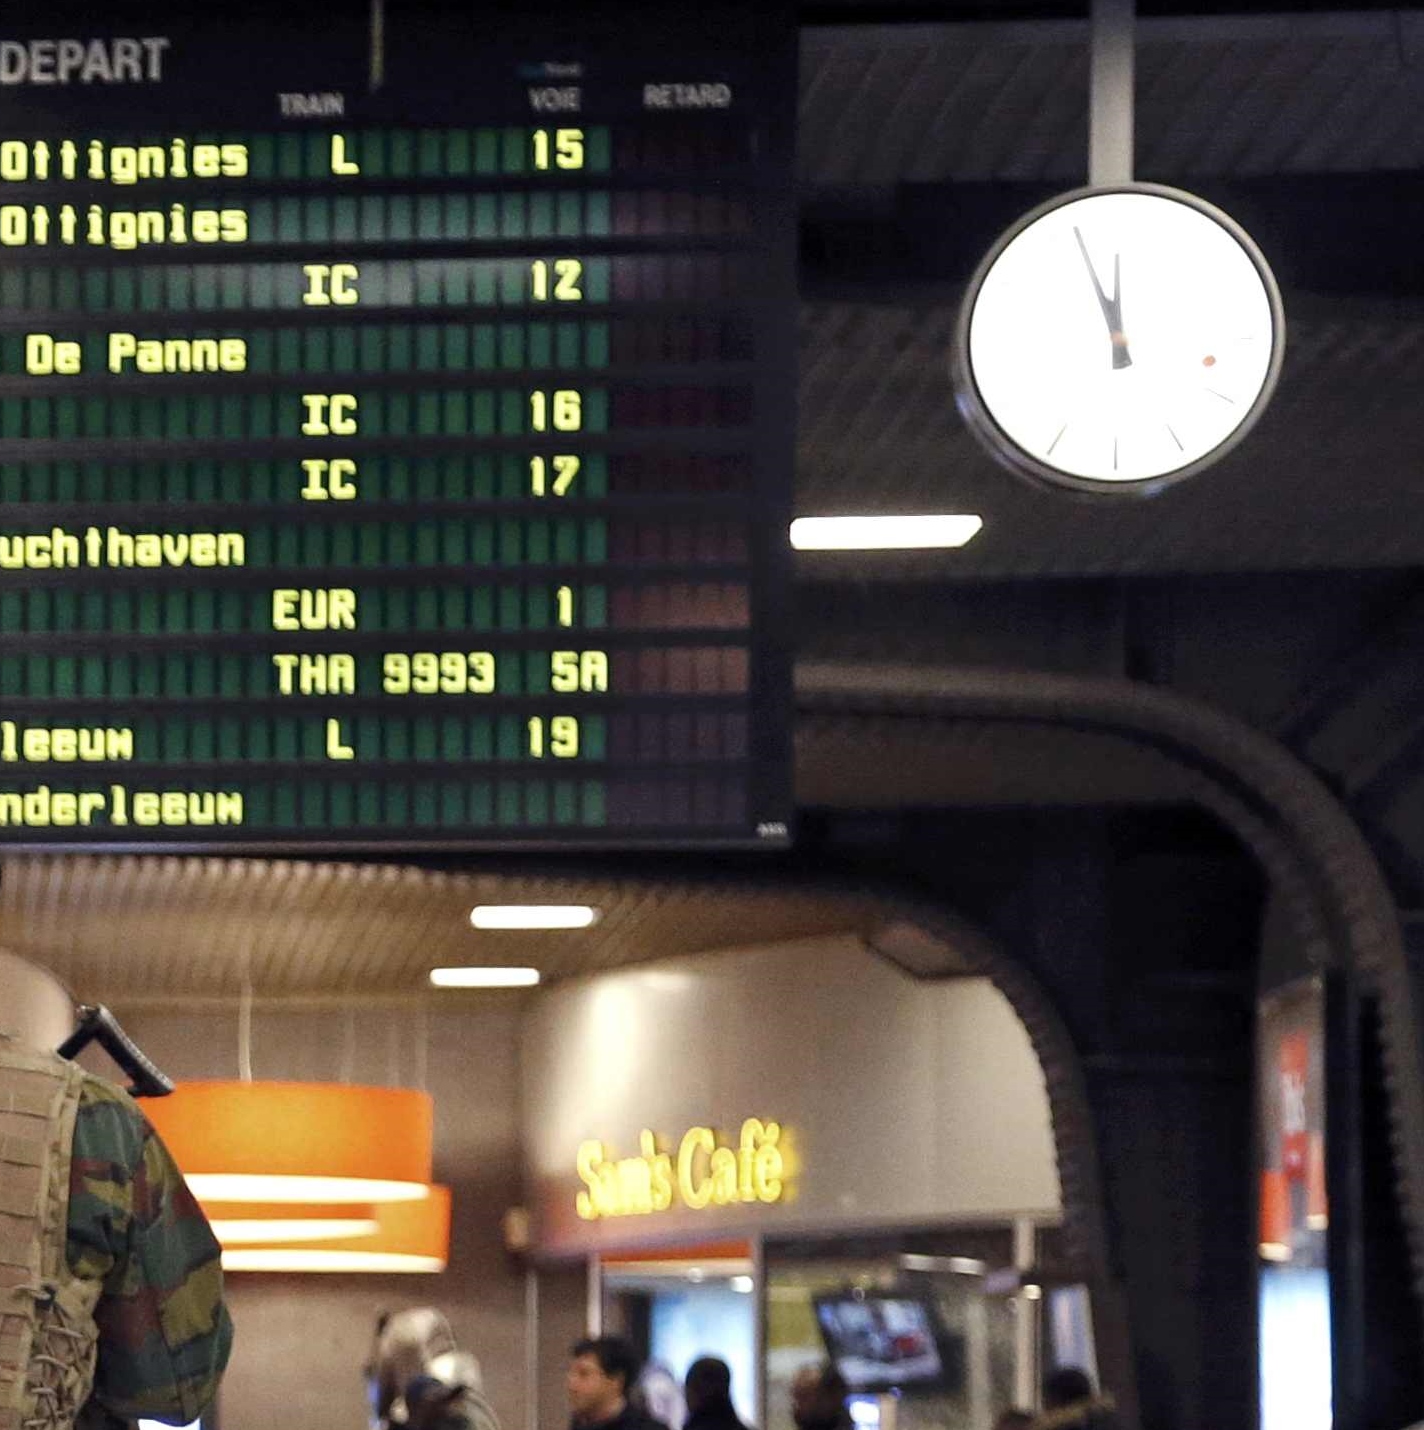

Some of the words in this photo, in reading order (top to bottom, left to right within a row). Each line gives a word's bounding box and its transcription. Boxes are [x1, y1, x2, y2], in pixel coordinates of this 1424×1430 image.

[278, 93, 344, 117] TRAIN
[529, 87, 582, 112] VOIE
[643, 83, 732, 109] RETARD
[0, 137, 248, 184] Ottignies
[331, 134, 359, 174] L
[534, 128, 583, 170] 15
[0, 203, 247, 250] Ottignies
[303, 263, 358, 305] IC
[532, 258, 582, 301] 12
[26, 333, 81, 374] De
[109, 332, 246, 373] Panne
[302, 393, 357, 435] IC
[531, 389, 581, 431] 16
[301, 458, 356, 500] IC
[531, 454, 580, 496] 17
[273, 588, 356, 630] EUR
[558, 585, 572, 626] 1
[273, 653, 355, 694] THA
[383, 651, 495, 693] 9993
[551, 650, 608, 692] 5A
[327, 718, 354, 759] L
[529, 715, 578, 757] 19
